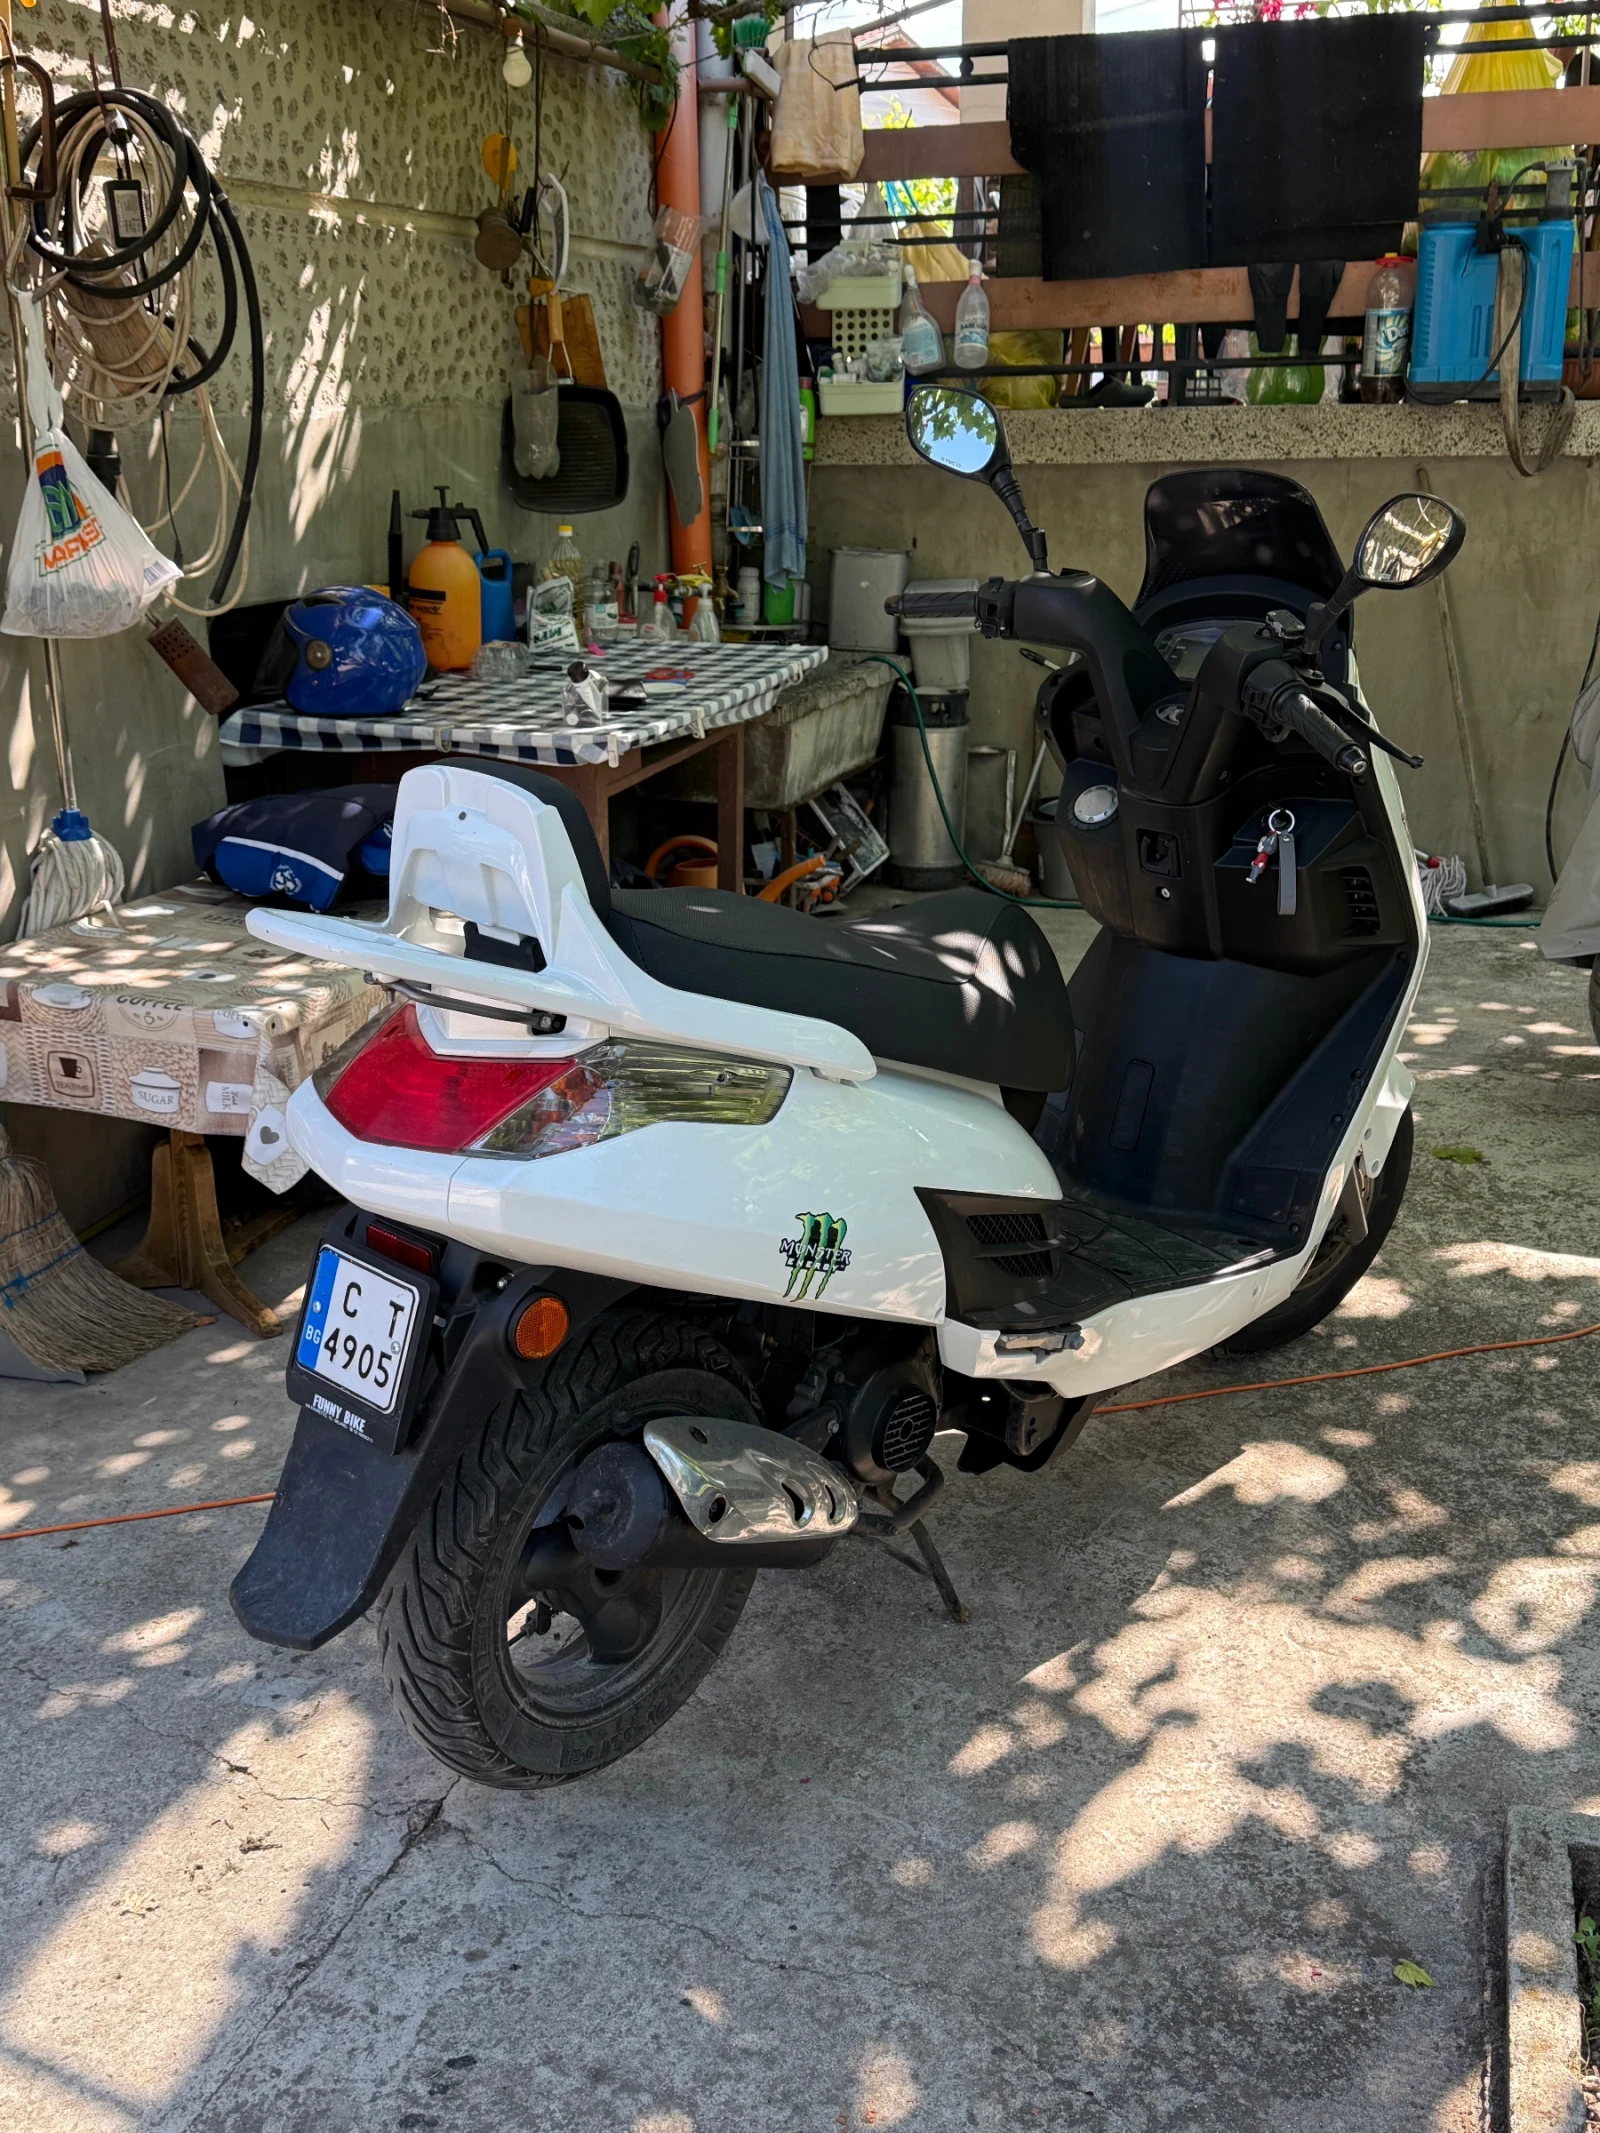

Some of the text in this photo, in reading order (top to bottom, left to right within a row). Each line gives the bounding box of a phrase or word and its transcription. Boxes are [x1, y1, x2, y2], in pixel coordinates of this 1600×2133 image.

[138, 1091, 174, 1105] SUGAR
[222, 1086, 231, 1110] MILK
[781, 1240, 850, 1265] MONSTER
[343, 1282, 405, 1339] C T
[305, 1325, 321, 1344] BG
[324, 1328, 392, 1388] 4905
[313, 1394, 342, 1420] FUNNY
[344, 1409, 366, 1433] BIKE
